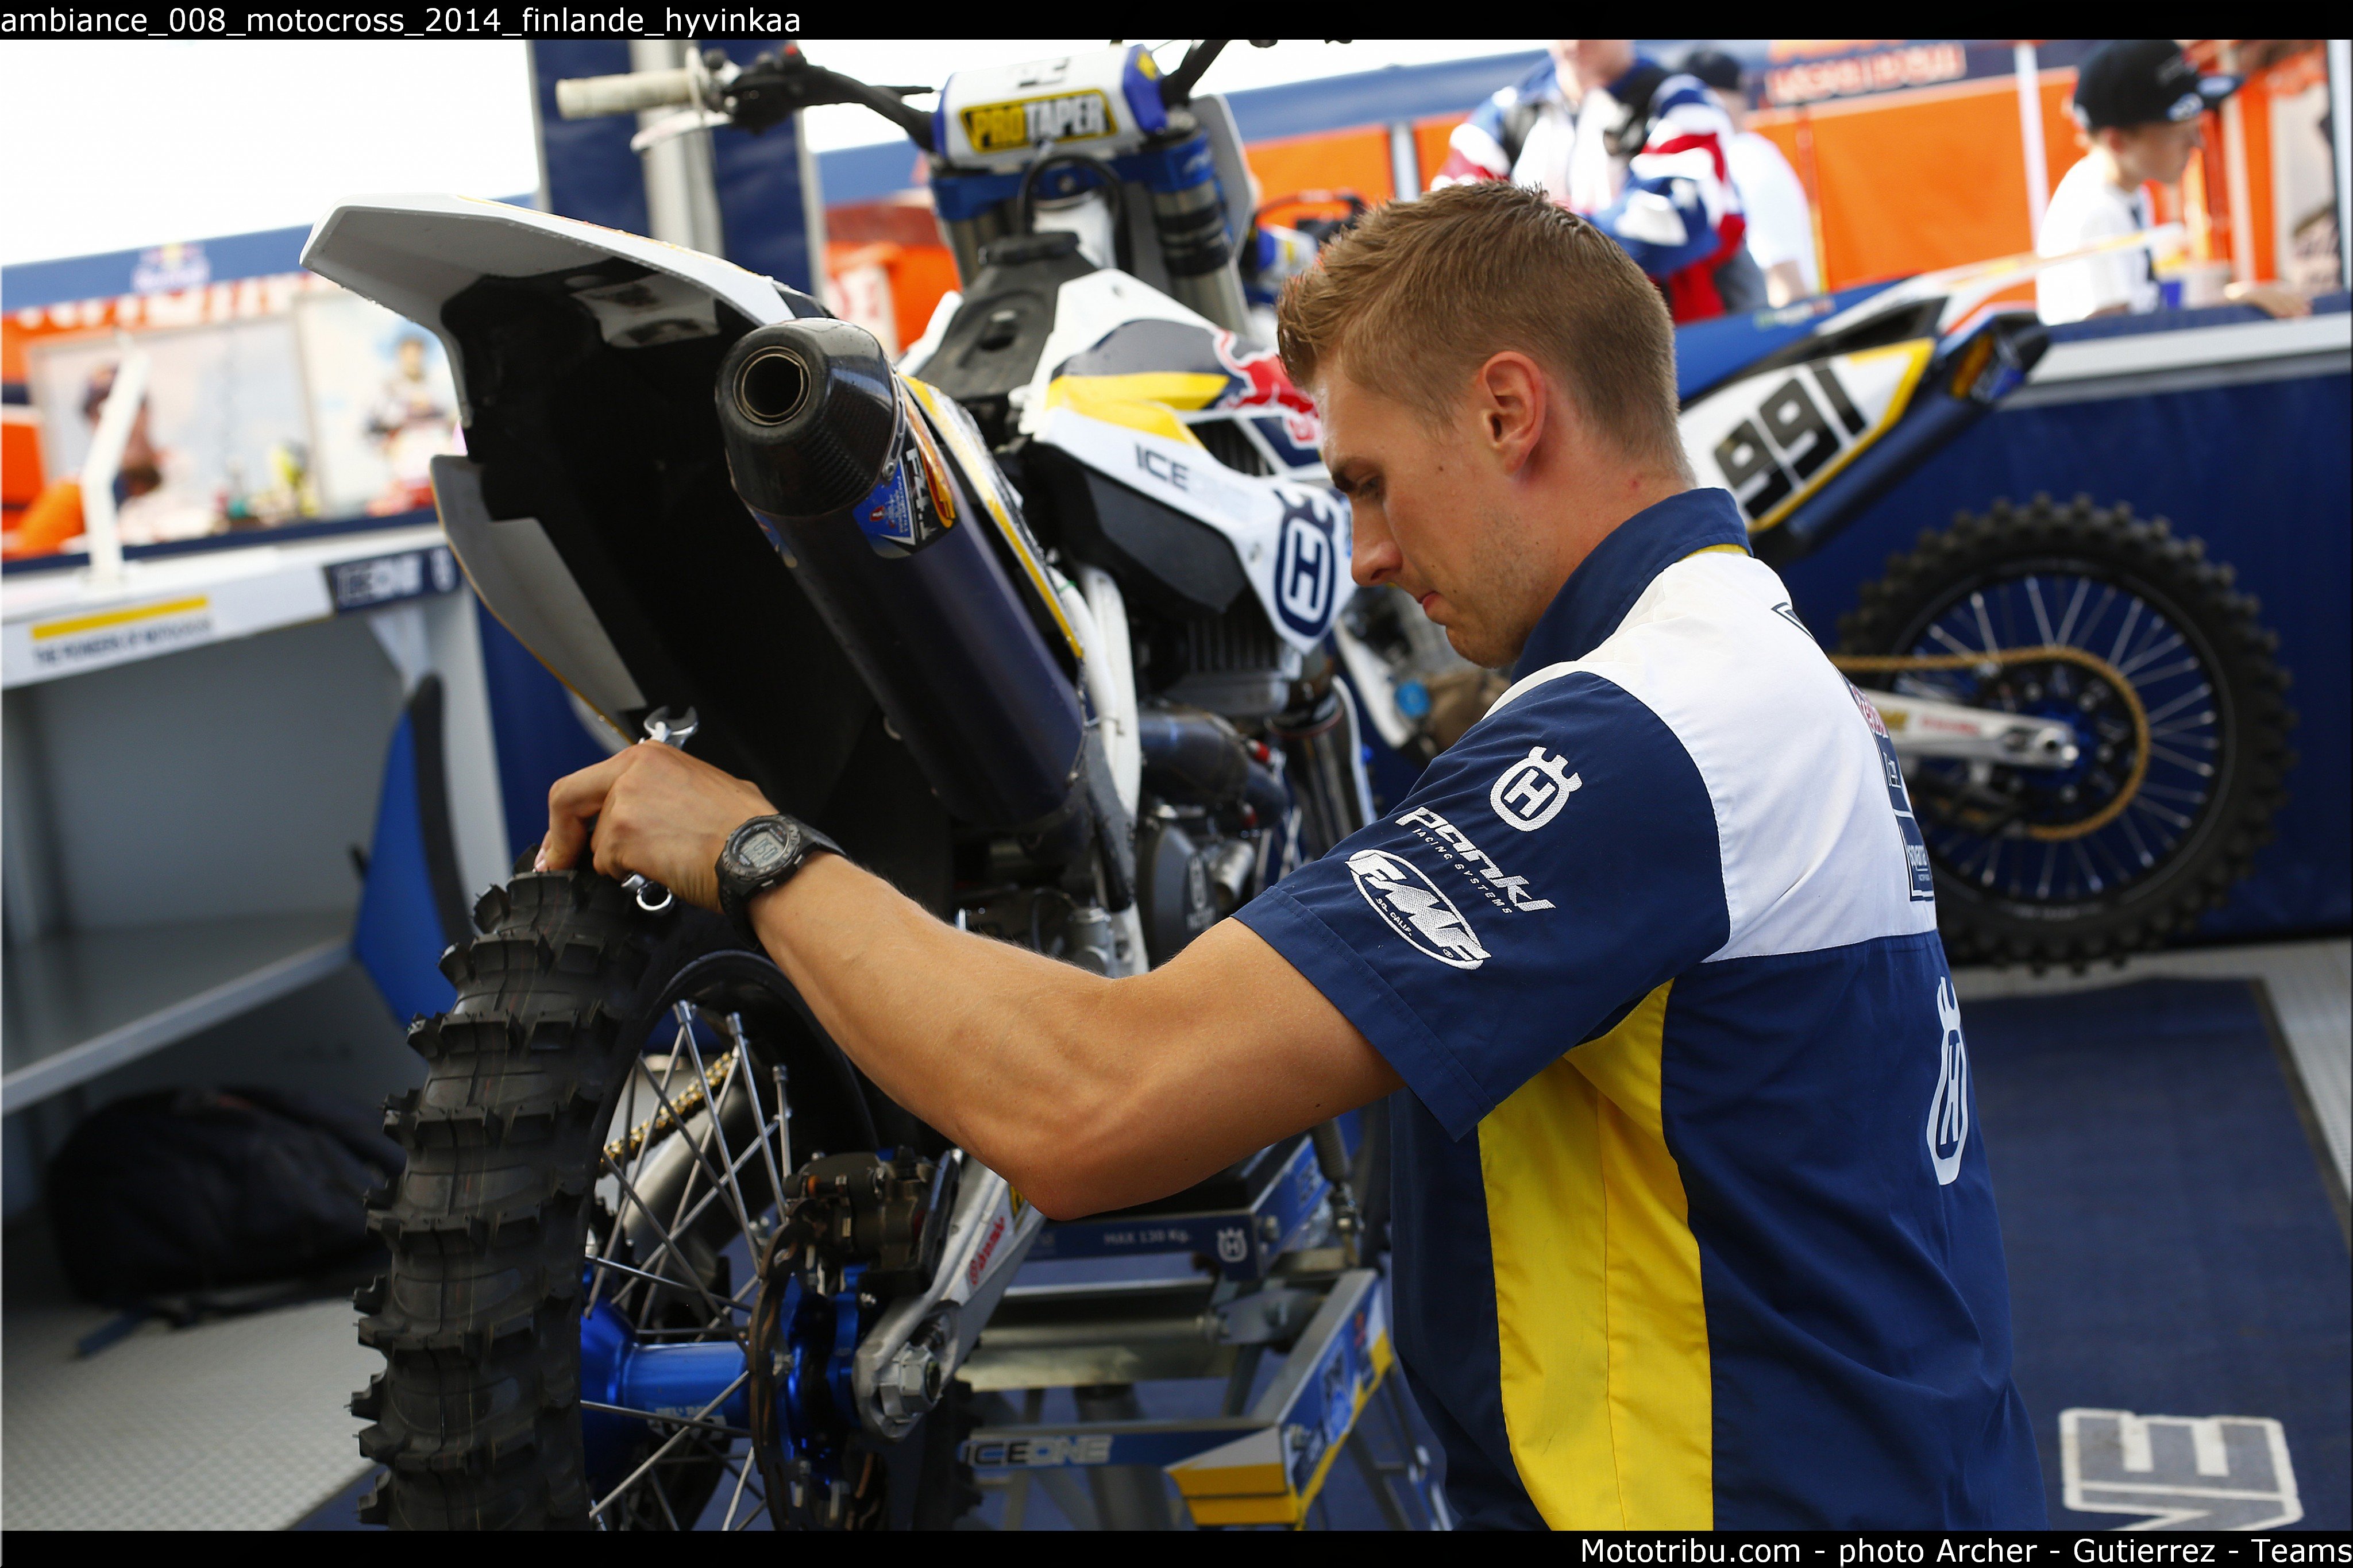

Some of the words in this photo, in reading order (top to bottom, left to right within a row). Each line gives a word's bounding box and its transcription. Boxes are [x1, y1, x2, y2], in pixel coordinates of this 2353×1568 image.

[1714, 368, 1866, 520] 991
[1344, 853, 1492, 961] FMF
[1389, 911, 1414, 937] CALIF.
[1454, 863, 1513, 914] SYSTEMS
